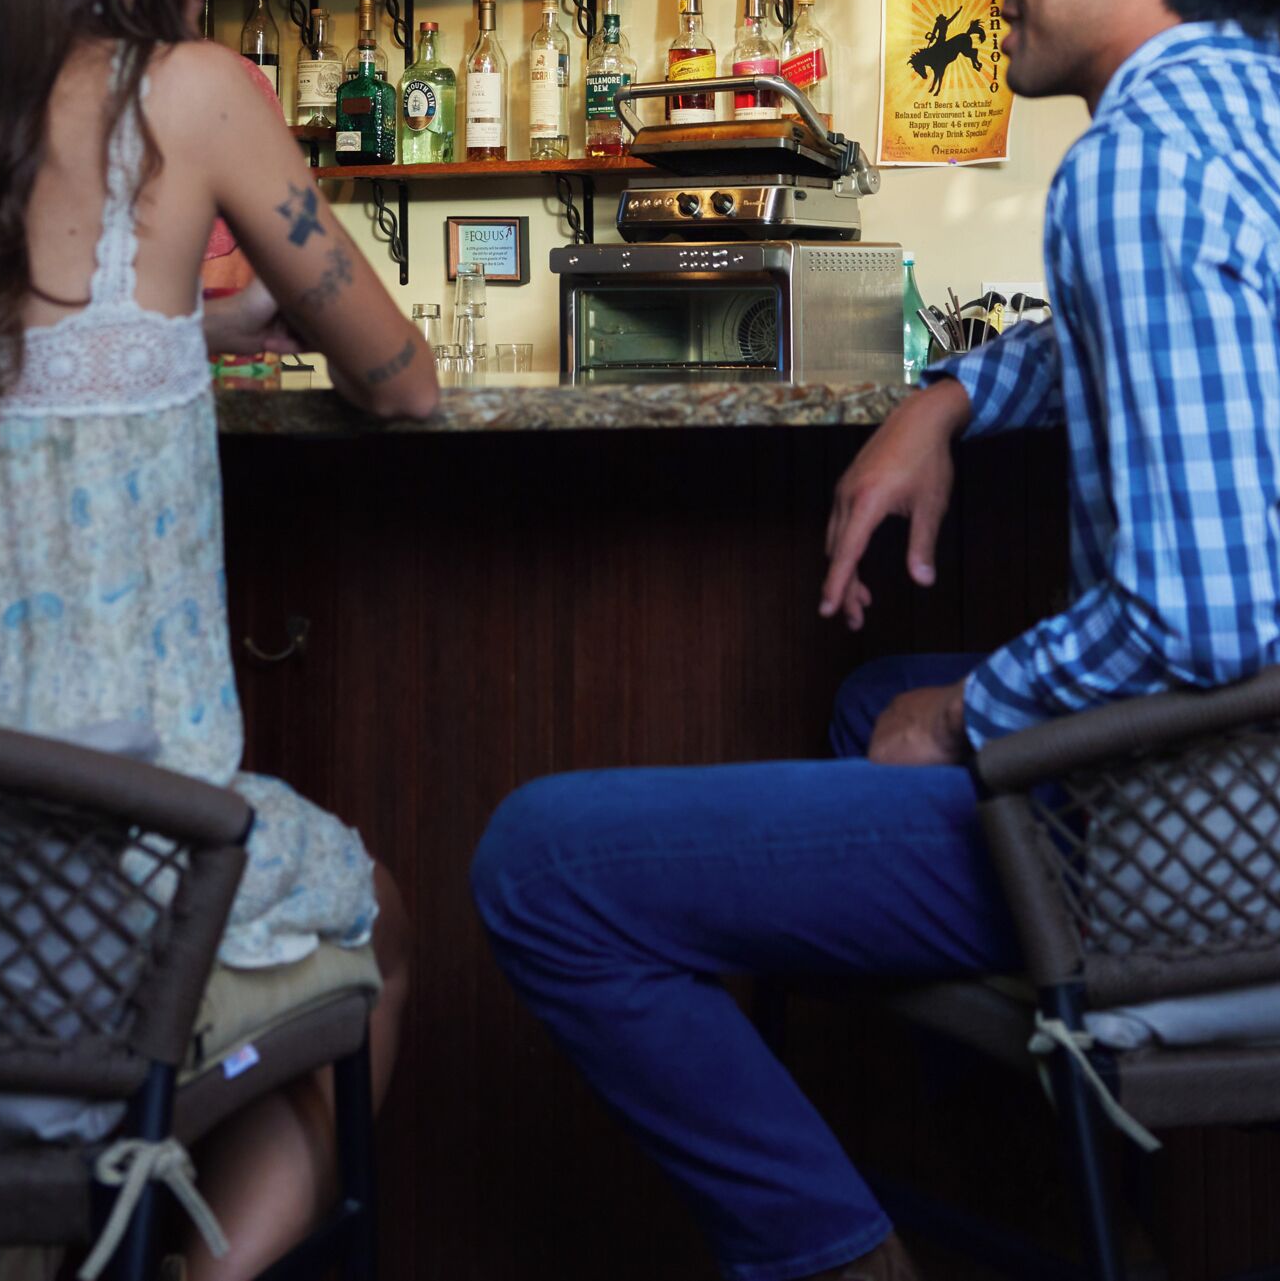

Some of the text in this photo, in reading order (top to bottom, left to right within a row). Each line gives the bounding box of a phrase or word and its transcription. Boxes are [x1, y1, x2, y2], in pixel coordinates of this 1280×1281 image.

[586, 76, 621, 86] TULLAMORE
[404, 82, 436, 108] PLYMOUTH GIN
[913, 101, 933, 109] Craft
[934, 101, 953, 109] Beers
[895, 111, 922, 119] Relaxed
[923, 111, 966, 119] Environment
[974, 110, 987, 118] Live
[909, 121, 930, 129] Happy
[932, 121, 948, 129] Hour
[913, 131, 944, 139] Weekday
[470, 230, 505, 242] EQUUS
